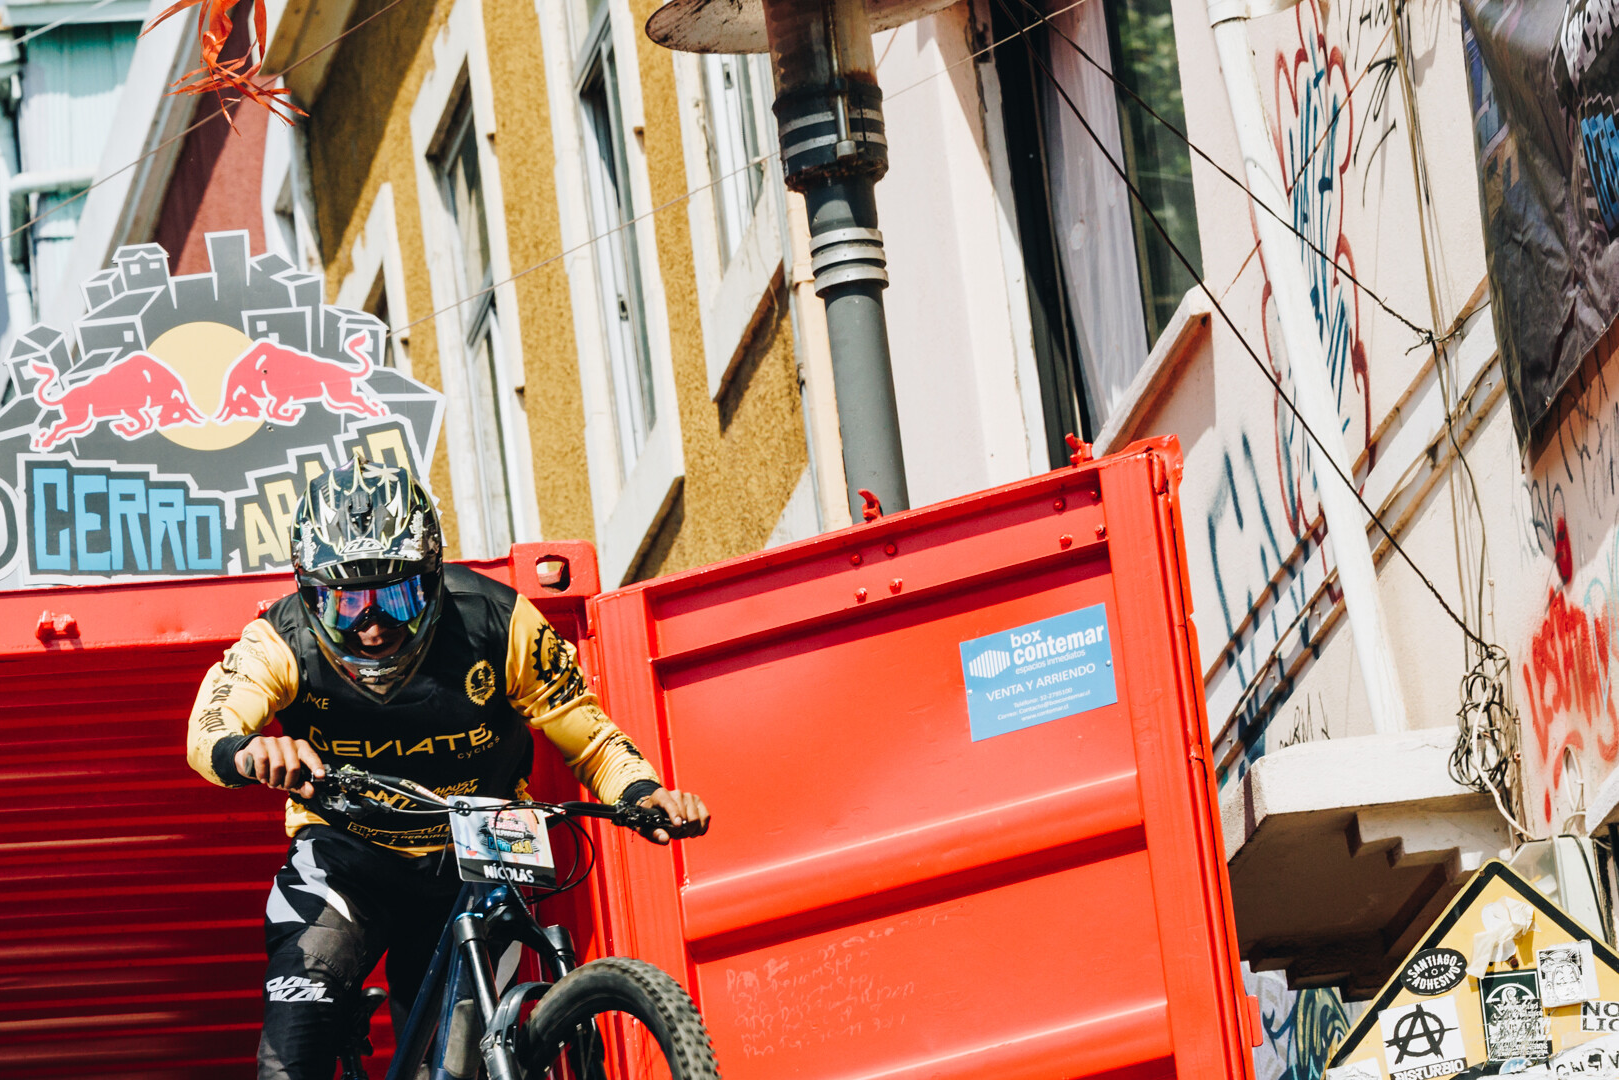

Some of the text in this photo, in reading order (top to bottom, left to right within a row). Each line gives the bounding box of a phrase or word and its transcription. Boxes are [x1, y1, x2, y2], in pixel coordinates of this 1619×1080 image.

[33, 468, 222, 571] CERRO
[242, 428, 411, 568] ABO
[1010, 630, 1042, 648] box
[1013, 625, 1104, 665] contemar
[1015, 649, 1086, 675] espacios inmediatos
[986, 663, 1096, 702] VENTA Y ARRIENDO
[309, 722, 493, 760] DEVIATE
[457, 736, 501, 760] cycles
[1407, 953, 1457, 978] SANTIAGO
[1412, 966, 1461, 990] ADHESIVO
